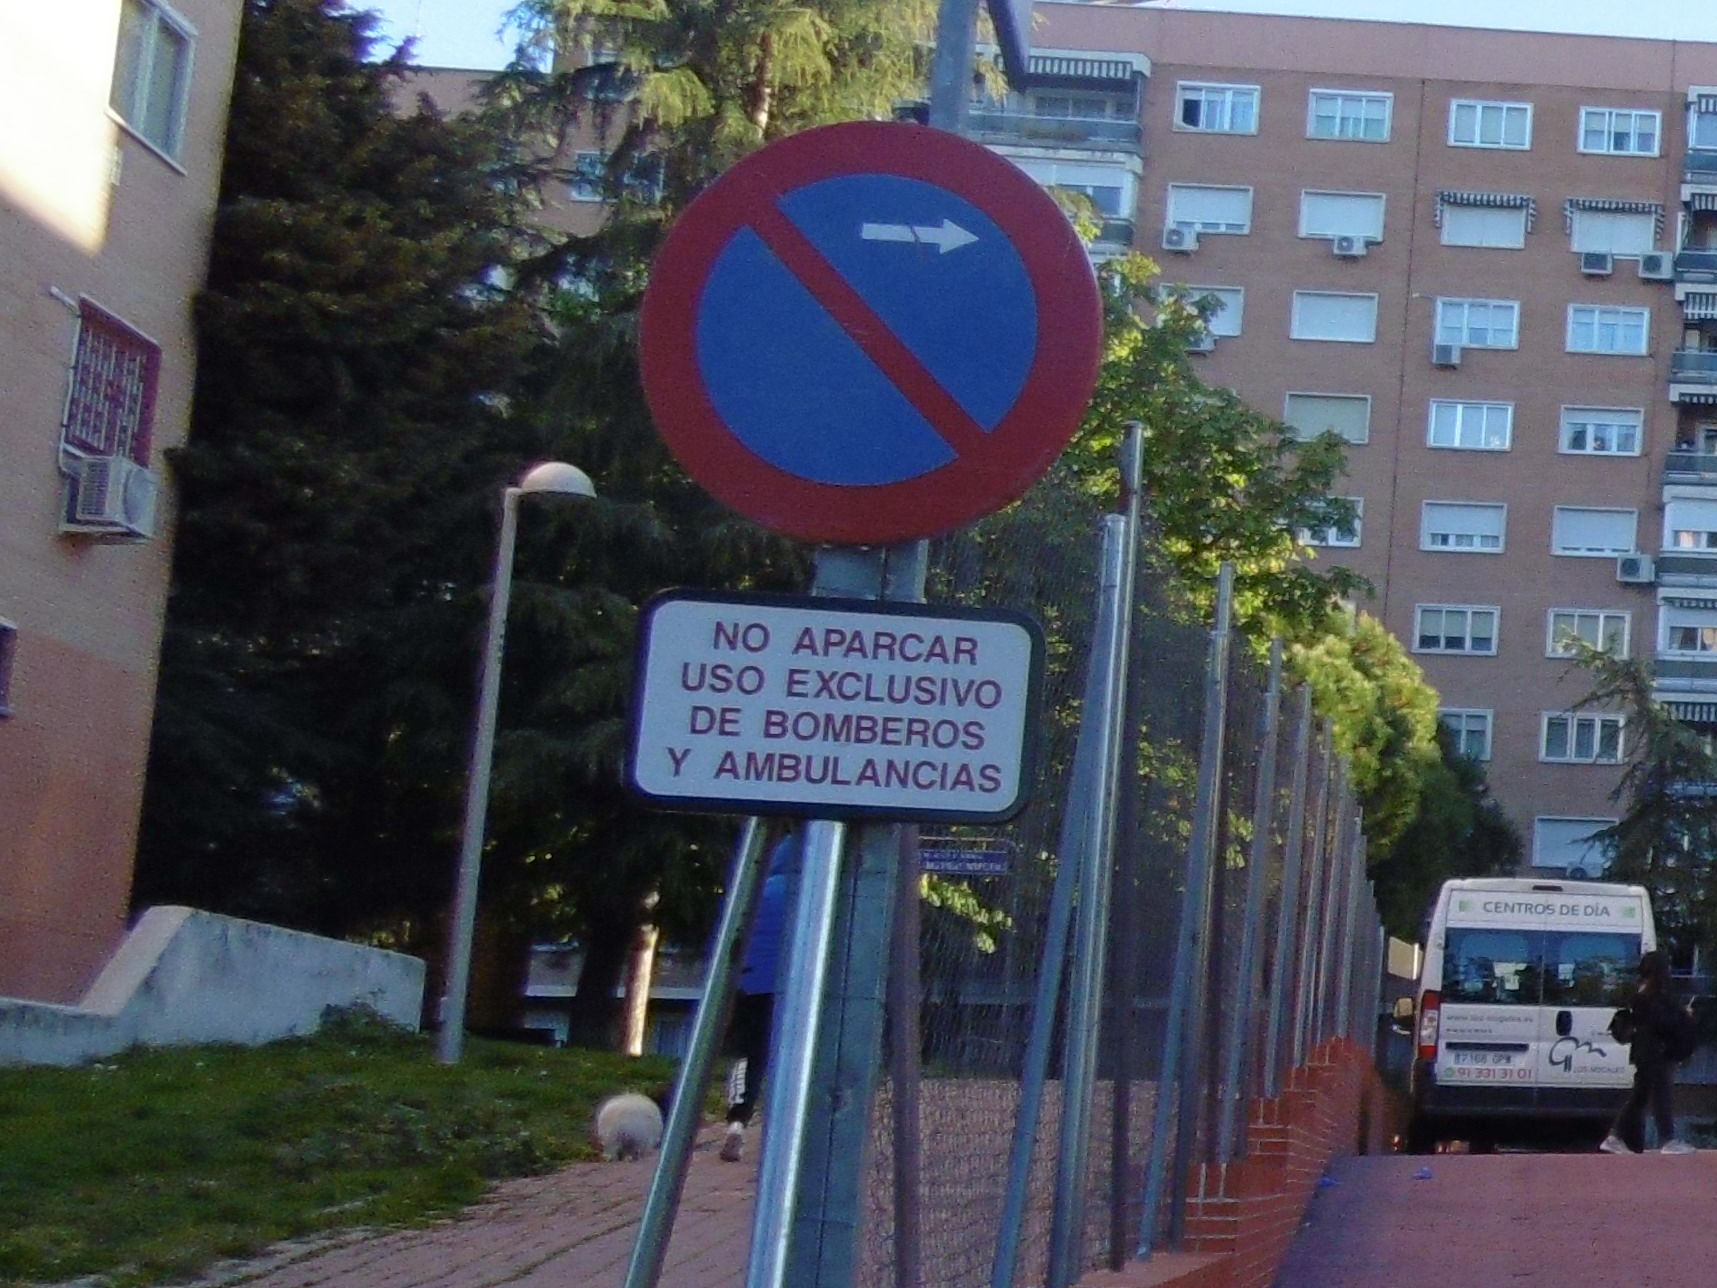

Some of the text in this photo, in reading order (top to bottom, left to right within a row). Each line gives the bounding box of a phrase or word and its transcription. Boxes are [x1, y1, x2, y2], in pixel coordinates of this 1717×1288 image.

[713, 621, 978, 665] NO APARCAR
[682, 662, 1001, 709] USO EXCLUSIVO
[690, 706, 985, 750] DE BOMBEROS
[667, 747, 1001, 793] Y AMBULANCIAS
[1483, 901, 1610, 917] CENTROS DE DÍA
[1457, 1067, 1532, 1079] 91 331 31 01
